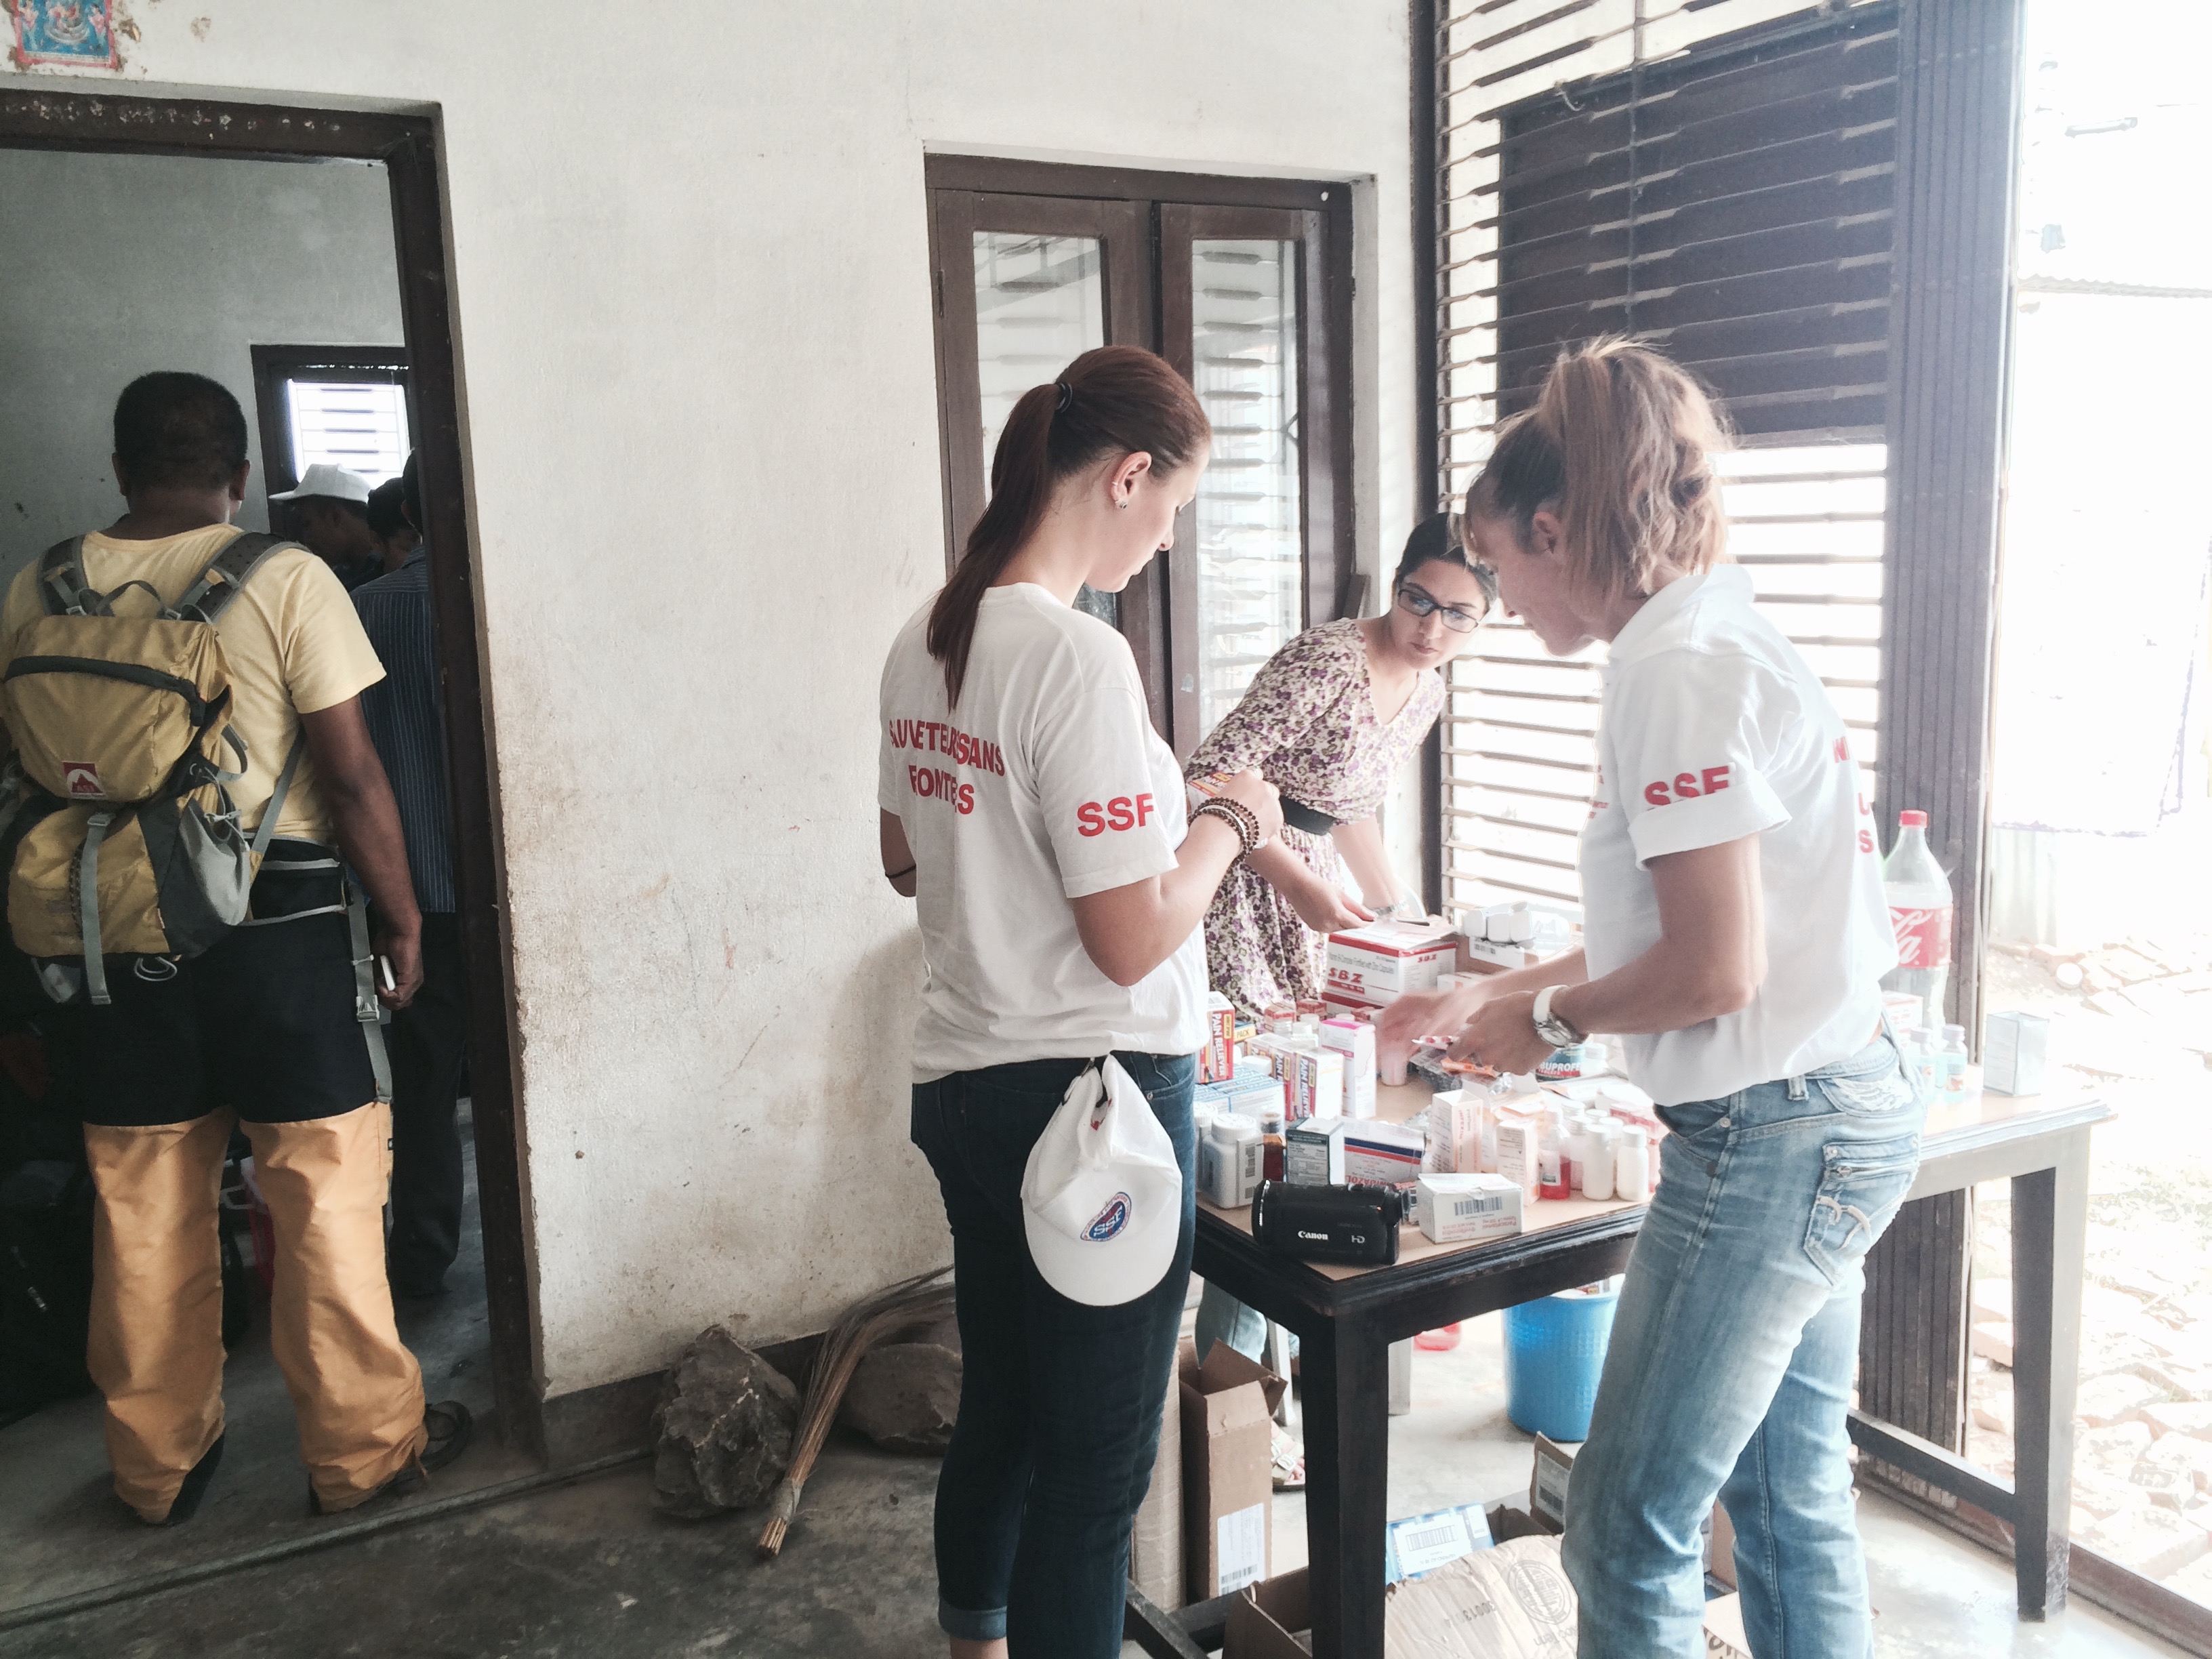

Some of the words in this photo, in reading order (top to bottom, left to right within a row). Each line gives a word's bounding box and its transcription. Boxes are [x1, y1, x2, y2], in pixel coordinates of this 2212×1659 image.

[1645, 765, 1729, 806] SSF
[1077, 793, 1154, 837] SSF
[1328, 967, 1364, 984] SBZ
[1212, 1012, 1223, 1037] PAIN
[1214, 1036, 1226, 1077] RELIEVER
[1540, 1061, 1581, 1071] BUPROFE
[1300, 1058, 1309, 1082] PAIN
[1298, 1230, 1328, 1241] Canon
[1351, 1235, 1366, 1244] HD
